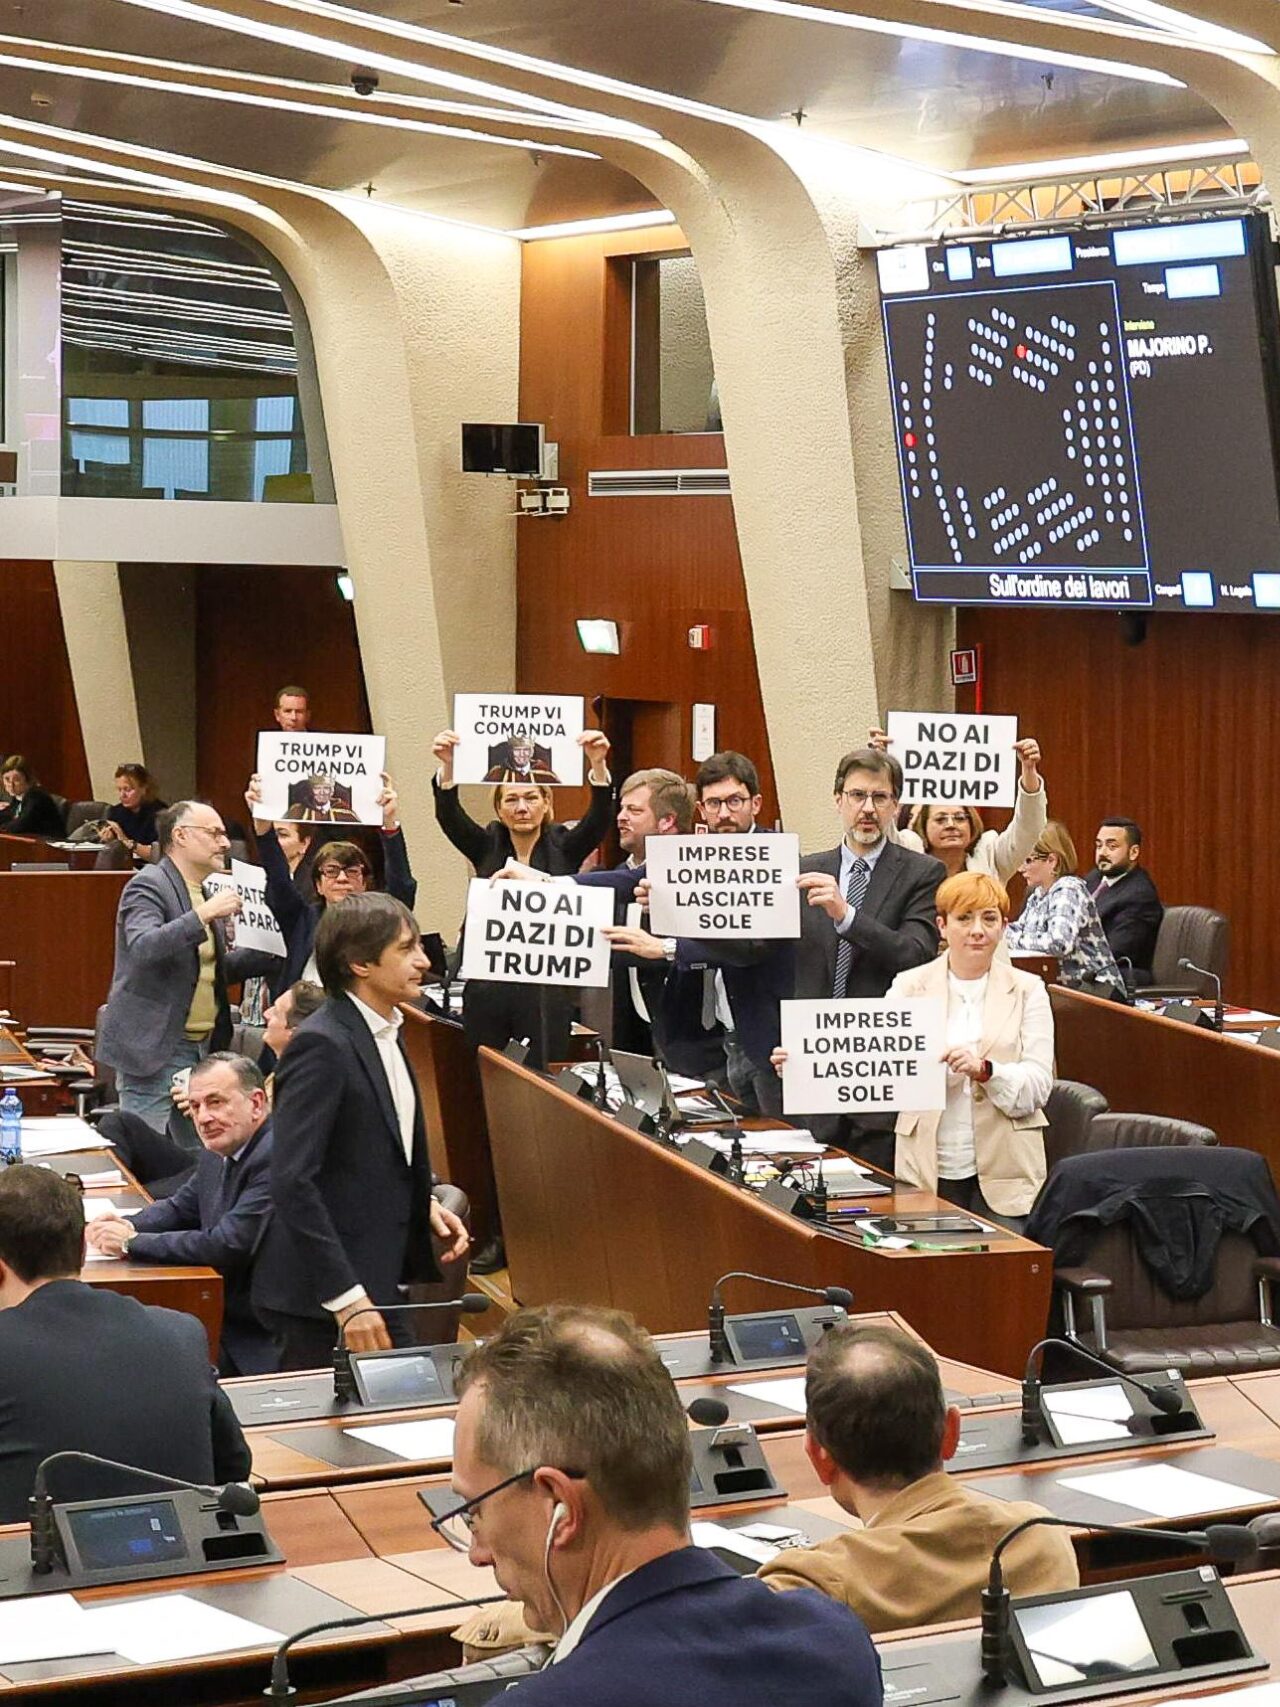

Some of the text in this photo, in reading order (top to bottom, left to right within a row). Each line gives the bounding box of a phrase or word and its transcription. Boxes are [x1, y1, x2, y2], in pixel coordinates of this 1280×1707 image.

[1127, 336, 1196, 358] MAJORINO
[989, 573, 1131, 599] Sull'ordine dei lavori
[478, 704, 561, 720] TRUMP VI
[474, 722, 566, 736] COMANDA
[917, 722, 989, 745] NO AI
[280, 742, 362, 759] TRUMP VI
[274, 759, 367, 775] COMANDA
[905, 750, 1000, 773] DAZI DI
[905, 778, 999, 800] TRUMP
[678, 845, 770, 862] IMPRESE
[666, 868, 782, 884] LOMBARDE
[501, 889, 583, 917] NO AI
[675, 891, 774, 907] LASCIATE
[248, 911, 281, 933] PARO
[699, 913, 752, 930] SOLE
[485, 919, 595, 949] DAZI DI
[485, 951, 592, 979] TRUMP
[816, 1011, 912, 1030] IMPRESE
[803, 1035, 926, 1055] LOMBARDE
[813, 1059, 918, 1079] LASCIATE
[837, 1084, 894, 1103] SOLE
